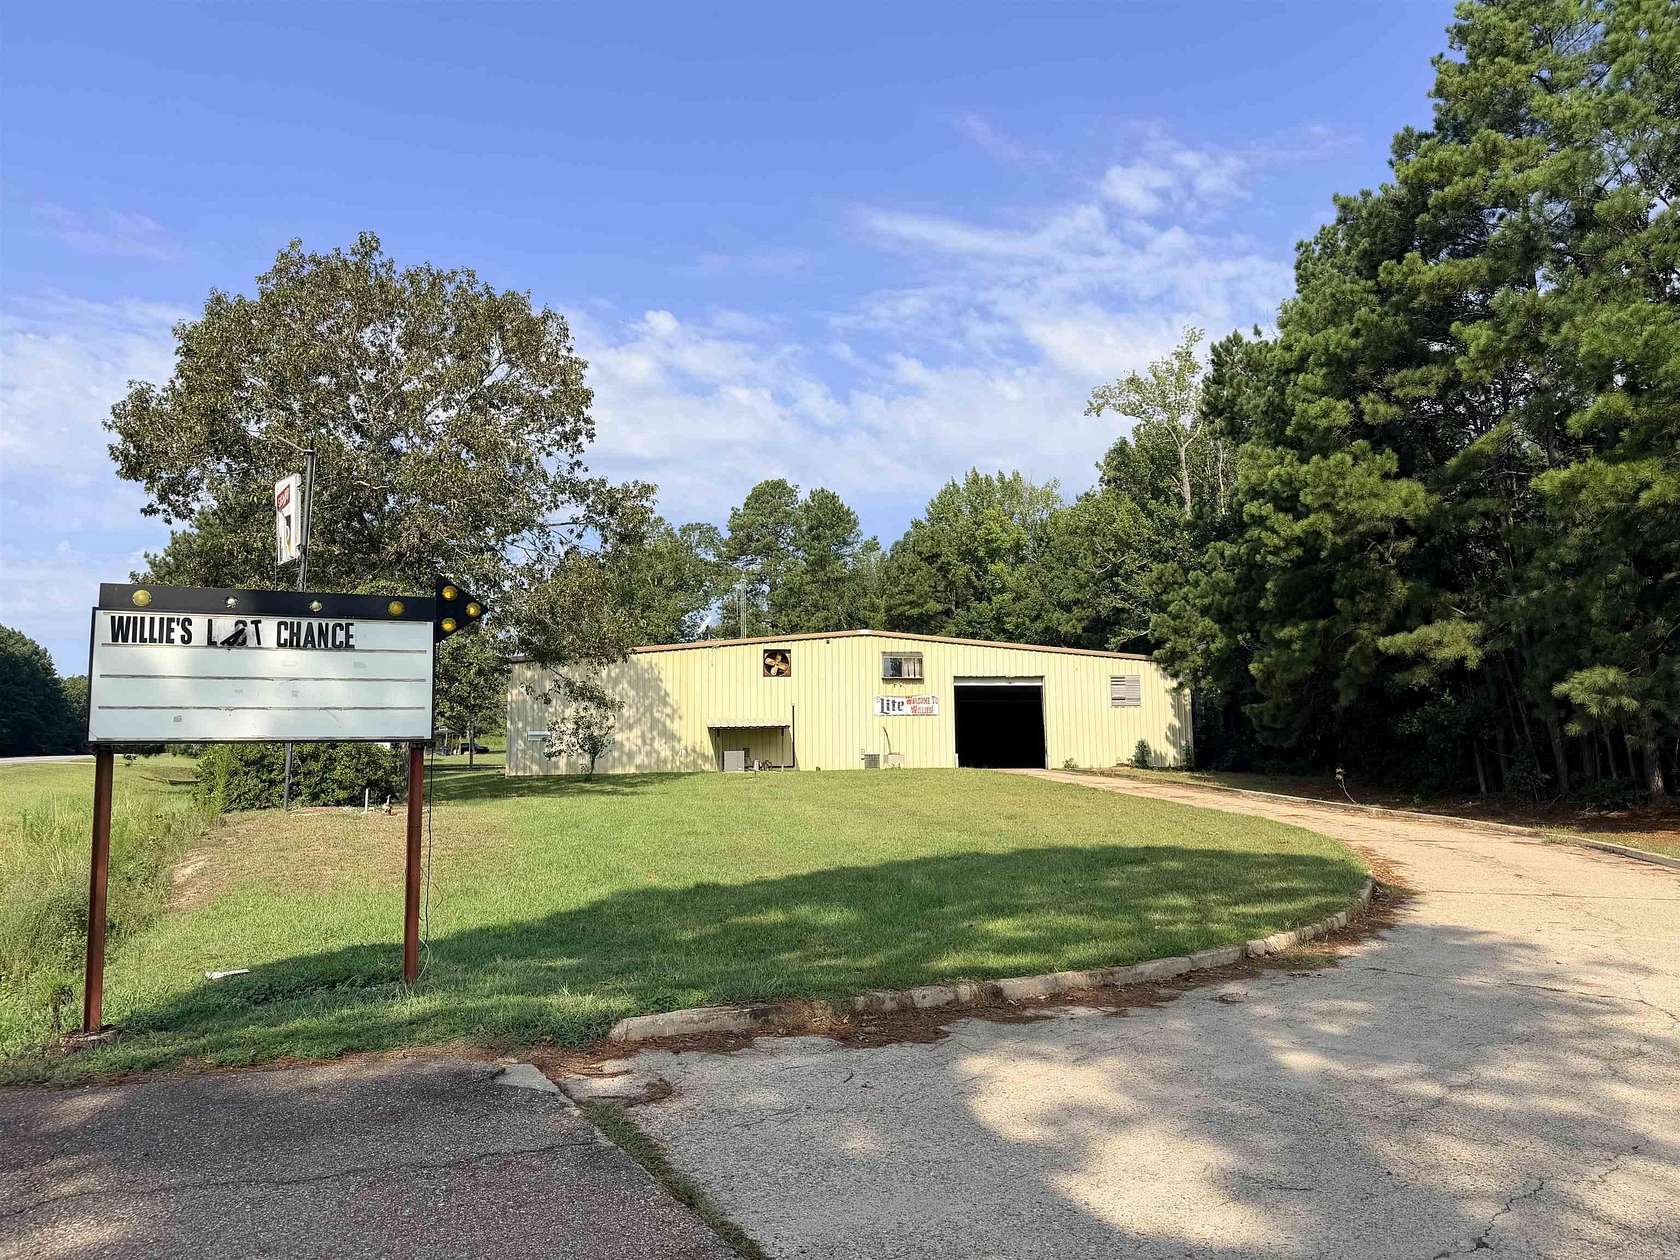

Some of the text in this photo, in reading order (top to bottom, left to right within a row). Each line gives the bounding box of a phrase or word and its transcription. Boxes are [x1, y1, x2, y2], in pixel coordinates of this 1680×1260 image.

[110, 615, 193, 645] WILLIE'S
[276, 620, 356, 649] CHANCE
[880, 698, 904, 714] Lite
